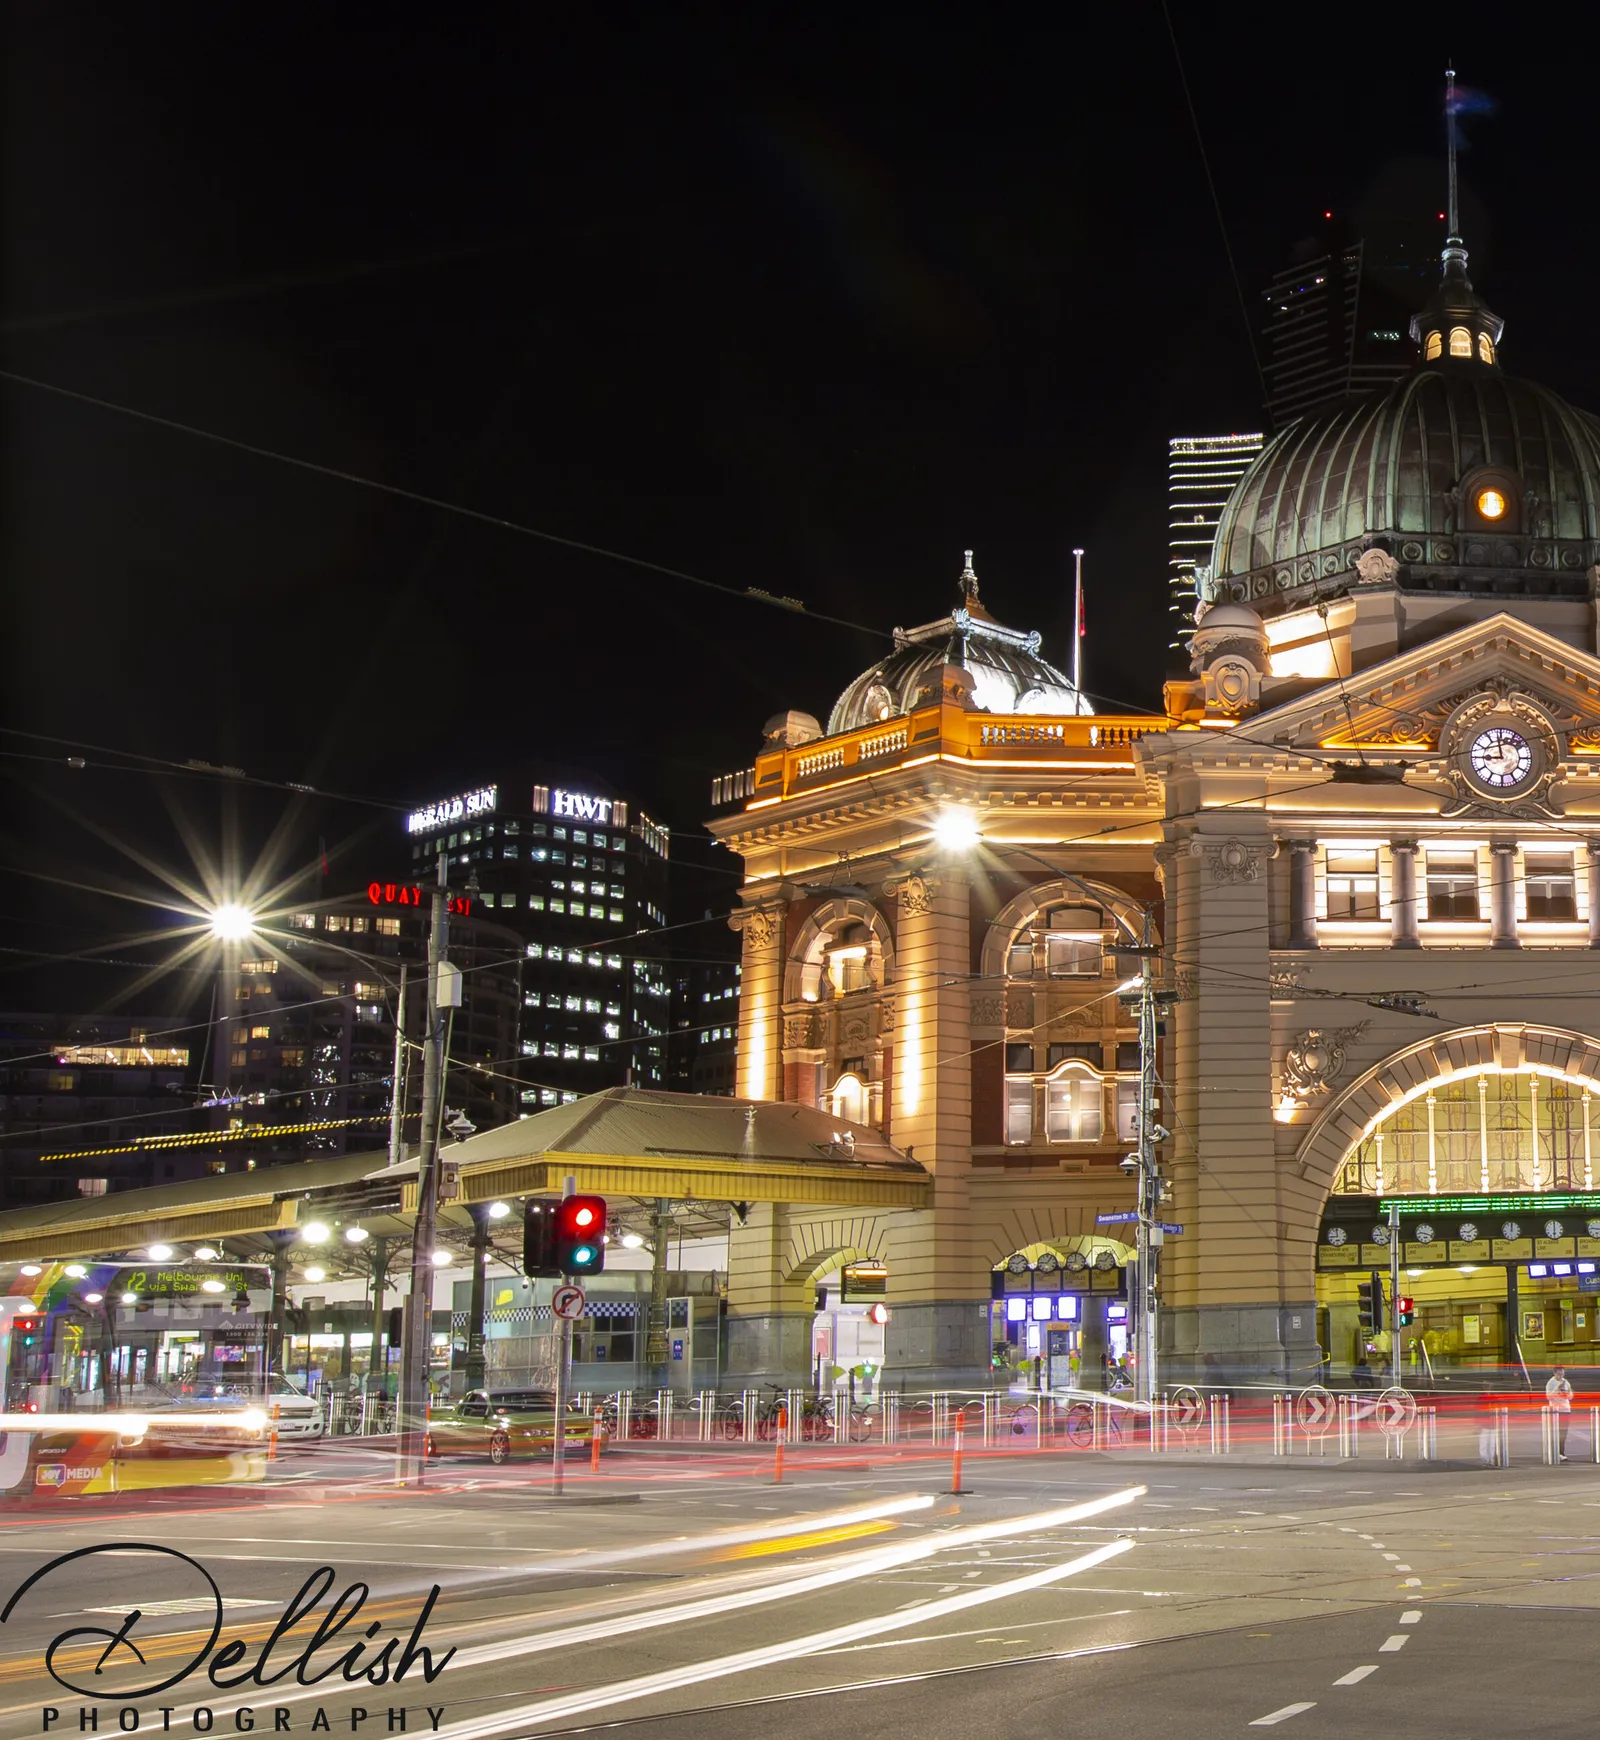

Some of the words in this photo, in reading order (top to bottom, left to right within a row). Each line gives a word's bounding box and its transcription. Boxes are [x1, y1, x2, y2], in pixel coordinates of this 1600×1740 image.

[467, 790, 495, 814] SUN
[553, 790, 612, 822] HWT
[367, 881, 422, 906] QUAY
[1098, 1214, 1122, 1222] Swanston
[158, 1272, 221, 1283] Melbourne
[226, 1272, 243, 1282] Uni
[149, 1282, 167, 1292] via
[173, 1282, 230, 1293] Swann
[235, 1282, 248, 1292] St
[235, 1322, 279, 1330] CITYWIDE
[41, 1469, 61, 1481] JOY
[67, 1467, 103, 1480] MEDIA
